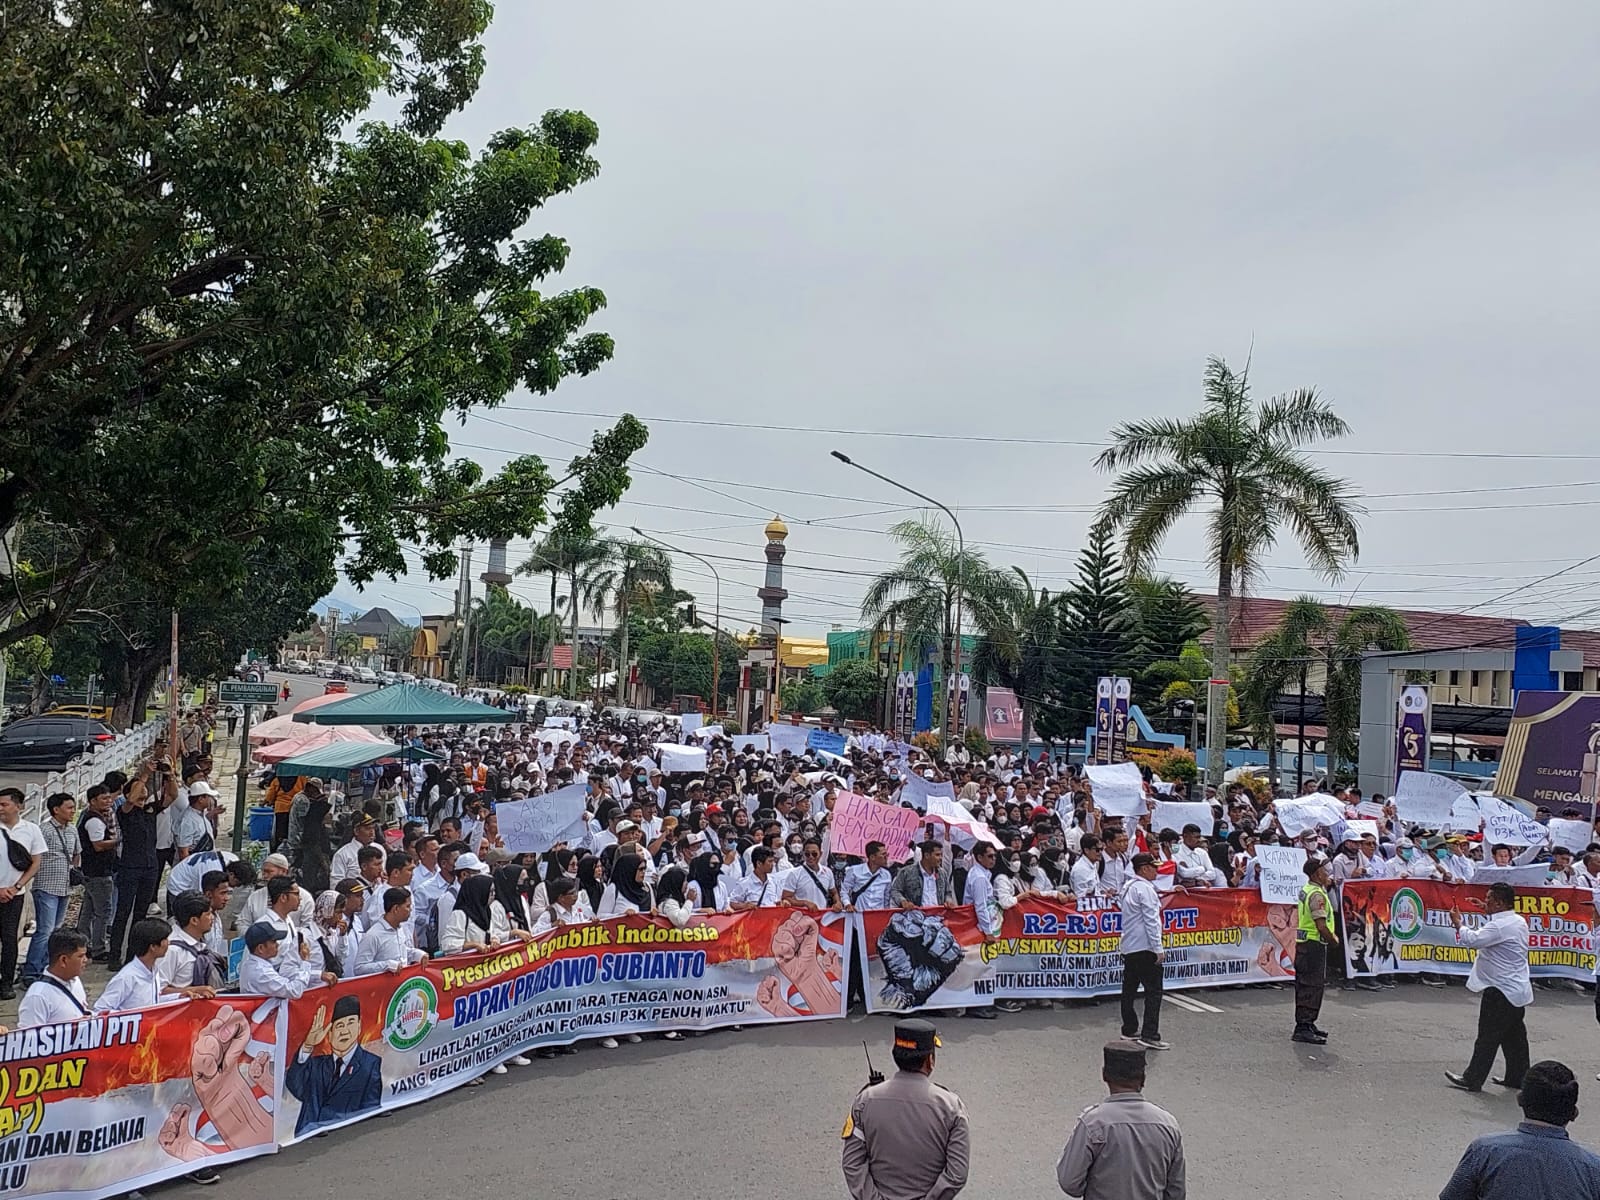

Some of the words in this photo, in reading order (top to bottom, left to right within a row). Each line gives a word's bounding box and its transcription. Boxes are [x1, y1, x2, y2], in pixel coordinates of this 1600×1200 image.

[1536, 767, 1578, 778] SELAMAT
[520, 795, 556, 817] AKSI
[1533, 789, 1593, 804] MENGAB
[513, 807, 558, 833] DAMAI
[846, 796, 911, 828] HARGAI
[835, 813, 918, 847] PENGABDIAN
[1263, 850, 1300, 869] KATANYA
[1268, 883, 1301, 898] FORMALIT
[1513, 895, 1570, 915] iRRo
[1023, 912, 1098, 935] R2-R3
[1100, 913, 1123, 933] GT
[1163, 908, 1200, 930] PTT
[1549, 916, 1589, 935] Duo
[1171, 927, 1242, 947] BENGKULU)
[441, 951, 525, 991] Presiden
[526, 924, 611, 963] Republik
[616, 923, 720, 945] Indonesia
[1040, 954, 1107, 970] SMA/SMK/SLB
[1434, 945, 1470, 963] SEMUA
[1528, 950, 1577, 967] MENJADI
[1578, 953, 1597, 971] P3
[1016, 972, 1075, 988] KEJELASAN
[1078, 970, 1107, 989] STATUS
[1177, 963, 1199, 978] WATU
[1200, 961, 1227, 976] HARGA
[1228, 959, 1249, 974] MATI
[452, 980, 514, 1029] BAPAK
[512, 954, 598, 1007] PRABOWO
[600, 950, 707, 983] SUBIANTO
[0, 1018, 104, 1062] HASILAN
[105, 1013, 144, 1046] PTT
[418, 1031, 481, 1067] LIHATLAH
[535, 999, 572, 1022] KAMI
[576, 994, 607, 1011] PARA
[610, 990, 667, 1005] TENAGA
[672, 988, 704, 1002] NON
[705, 985, 729, 999] ASN
[391, 1073, 426, 1096] YANG
[430, 1056, 473, 1082] BELUM
[474, 1019, 556, 1066] MENDAPATKAN
[559, 1010, 616, 1034] FORMASI
[619, 1008, 647, 1022] P3K
[651, 1006, 702, 1020] PENUH
[15, 1059, 88, 1098] DAN
[0, 1094, 45, 1139] AP)
[23, 1130, 72, 1159] DAN
[75, 1115, 147, 1155] BELANJA
[0, 1163, 29, 1192] LU
